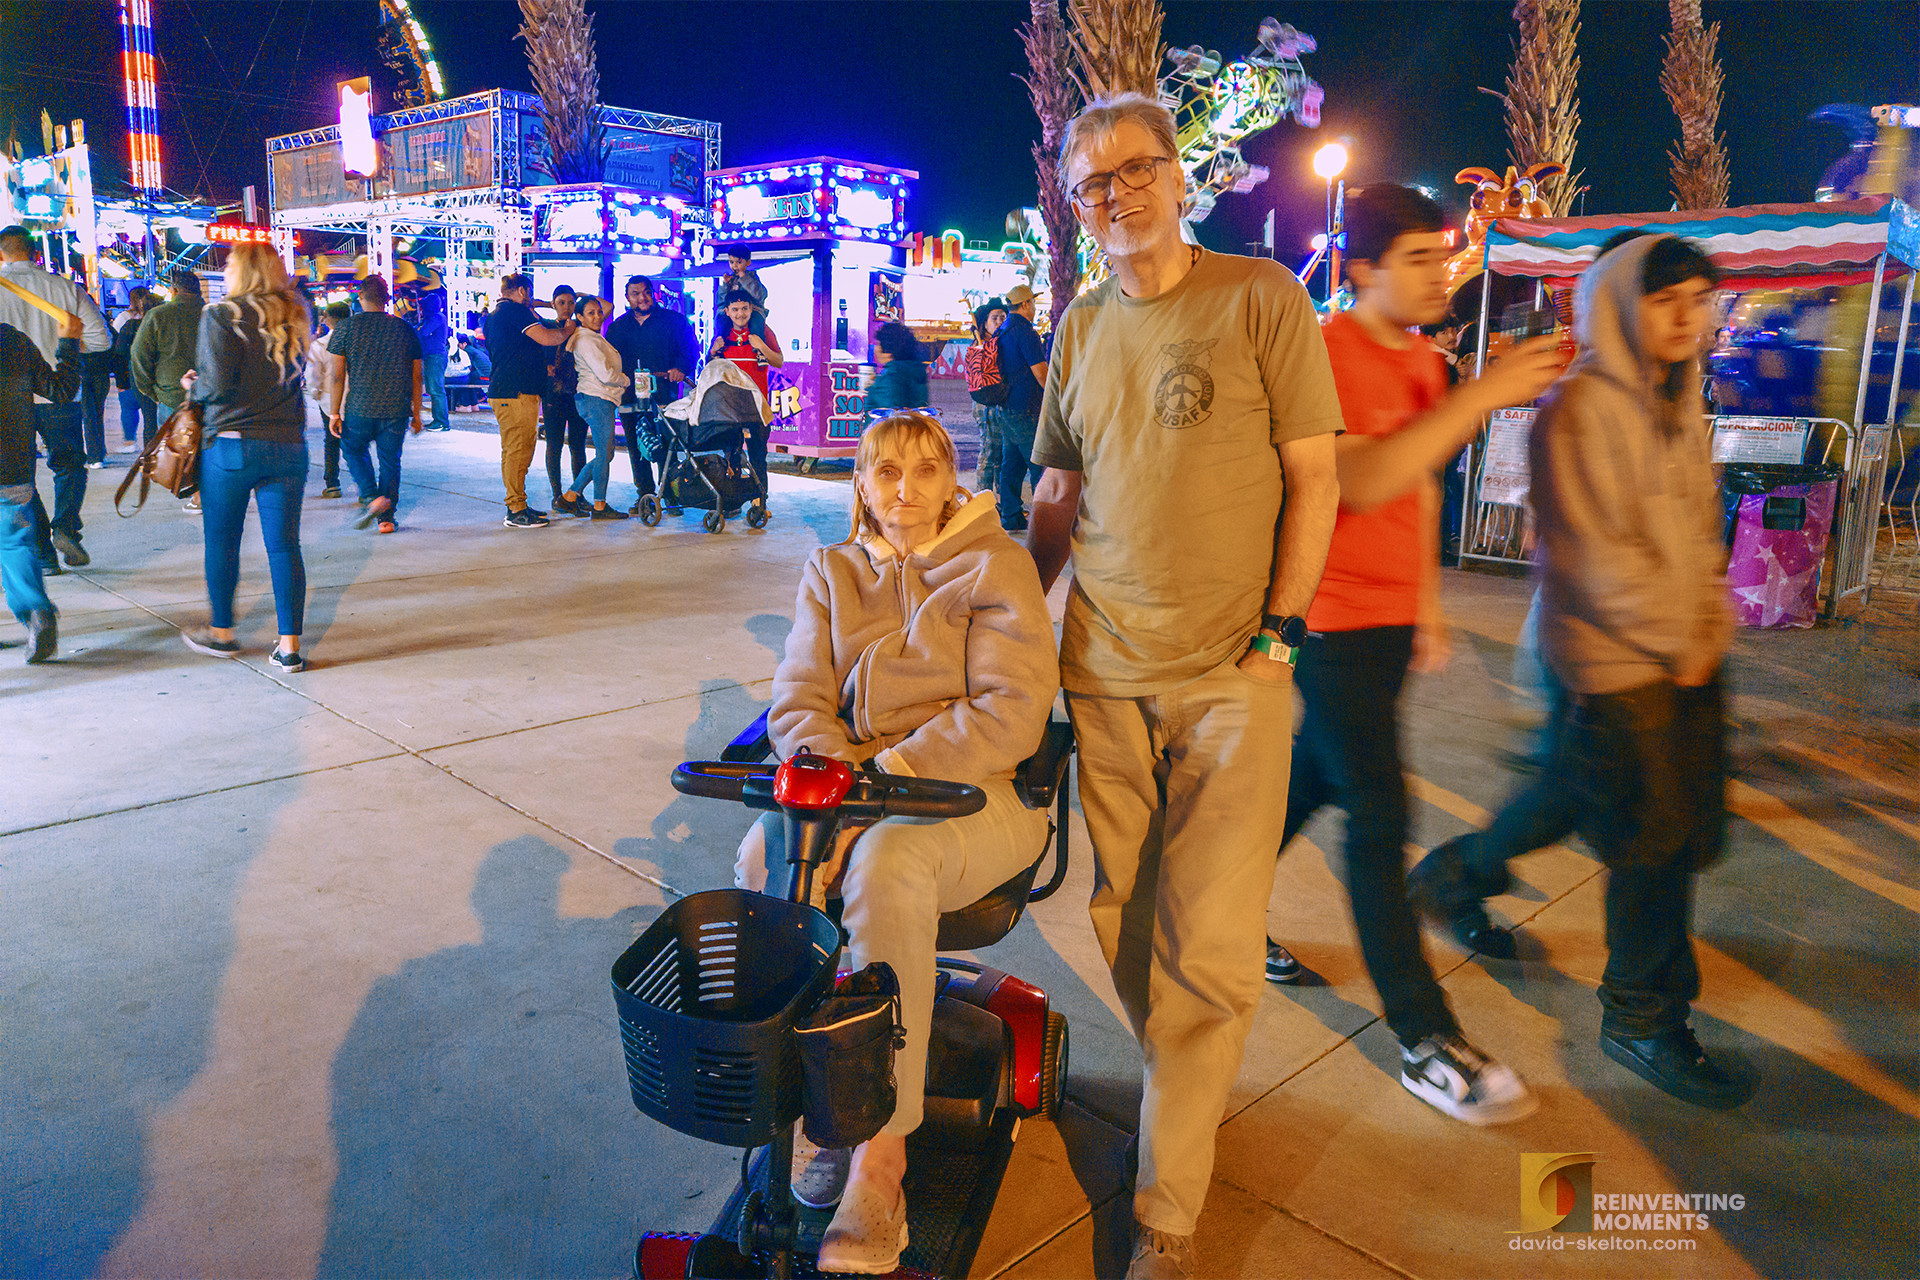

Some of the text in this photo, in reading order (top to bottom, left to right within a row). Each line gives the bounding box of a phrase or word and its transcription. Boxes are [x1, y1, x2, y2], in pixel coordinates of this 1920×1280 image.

[770, 386, 802, 419] ER
[835, 396, 864, 414] SO
[1162, 408, 1199, 426] USAF
[1504, 410, 1536, 420] SAFE
[829, 420, 860, 437] HE
